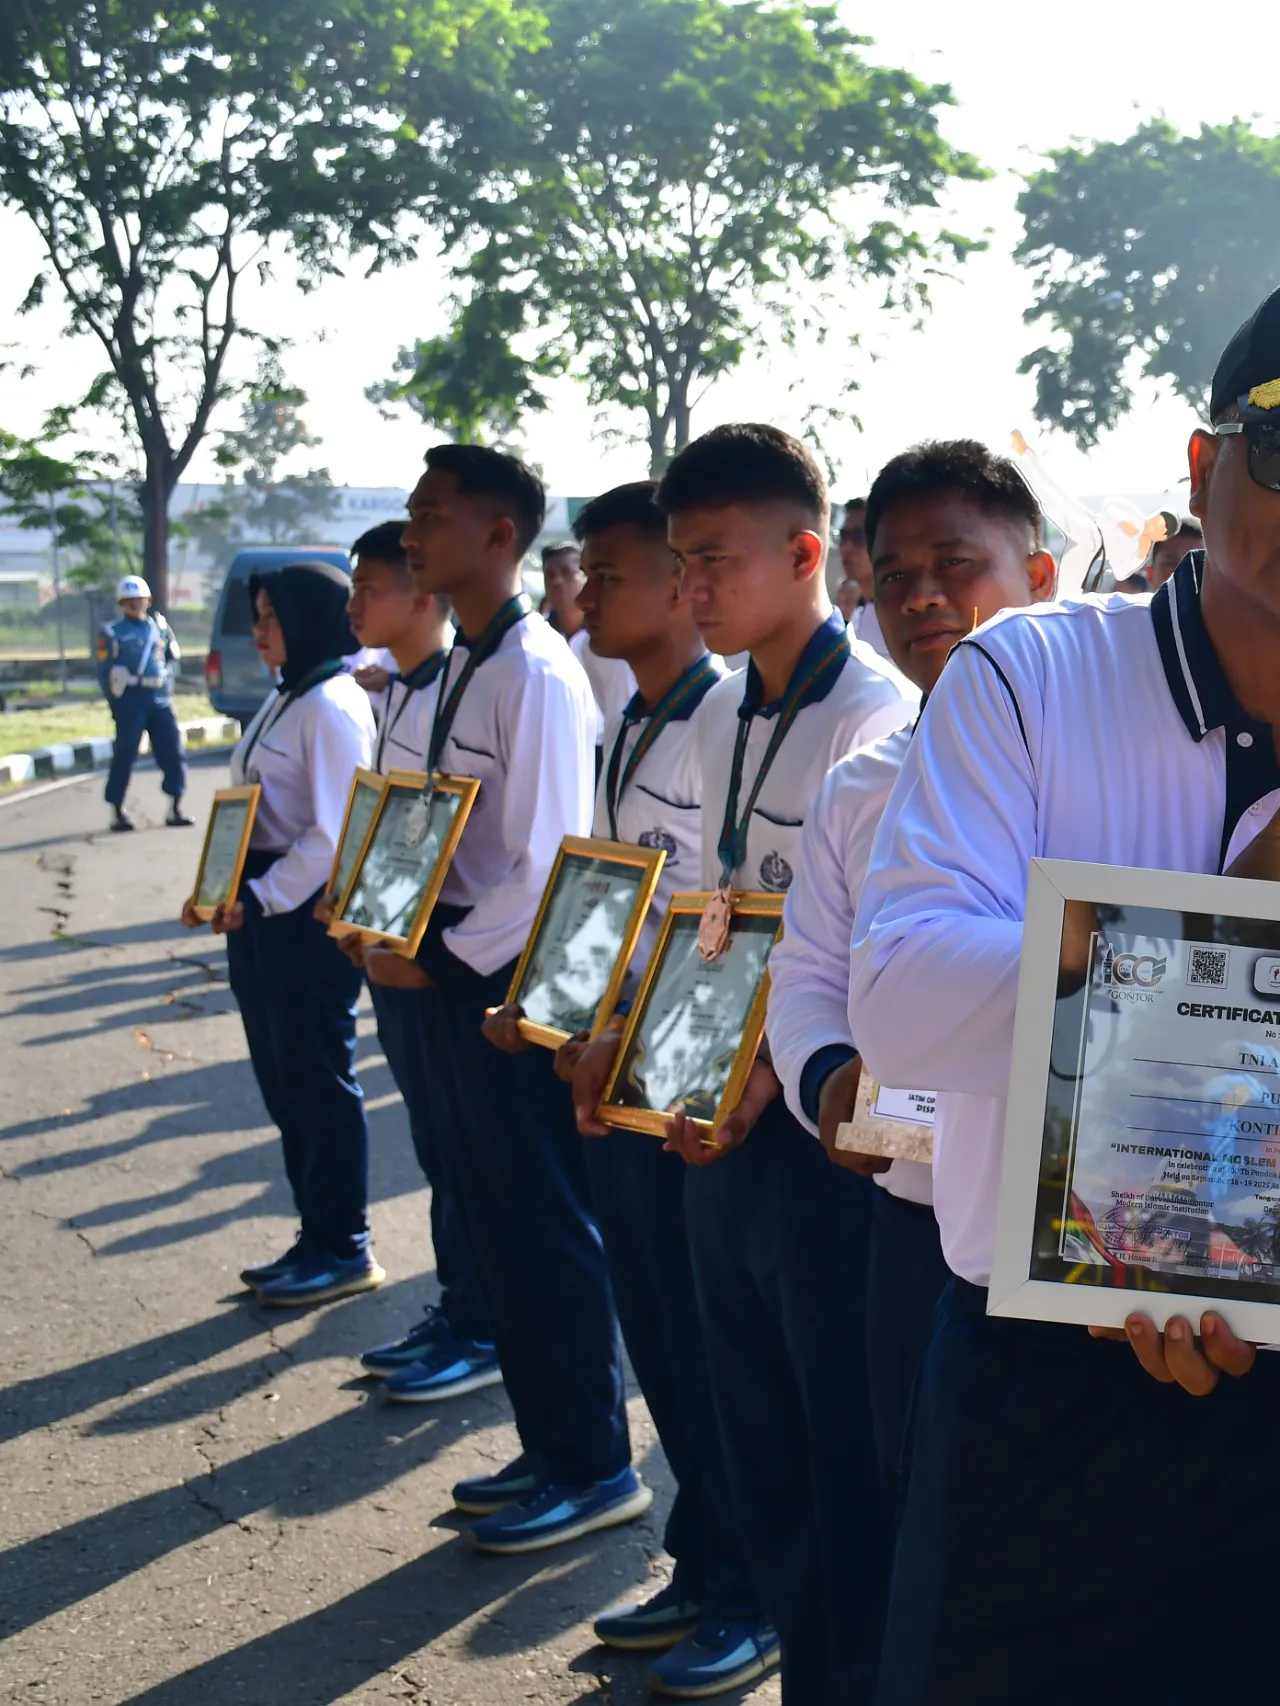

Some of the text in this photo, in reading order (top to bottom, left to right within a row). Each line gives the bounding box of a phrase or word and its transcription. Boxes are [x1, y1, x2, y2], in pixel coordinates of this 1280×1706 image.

[1110, 990, 1154, 1003] GONTOR
[1239, 1052, 1265, 1067] TNI
[1163, 1171, 1180, 1180] Held
[1231, 1178, 1239, 1186] 16
[1254, 1180, 1270, 1189] 2025
[1111, 1190, 1135, 1199] Sheikh
[1115, 1199, 1209, 1215] Modern Islamic Institution
